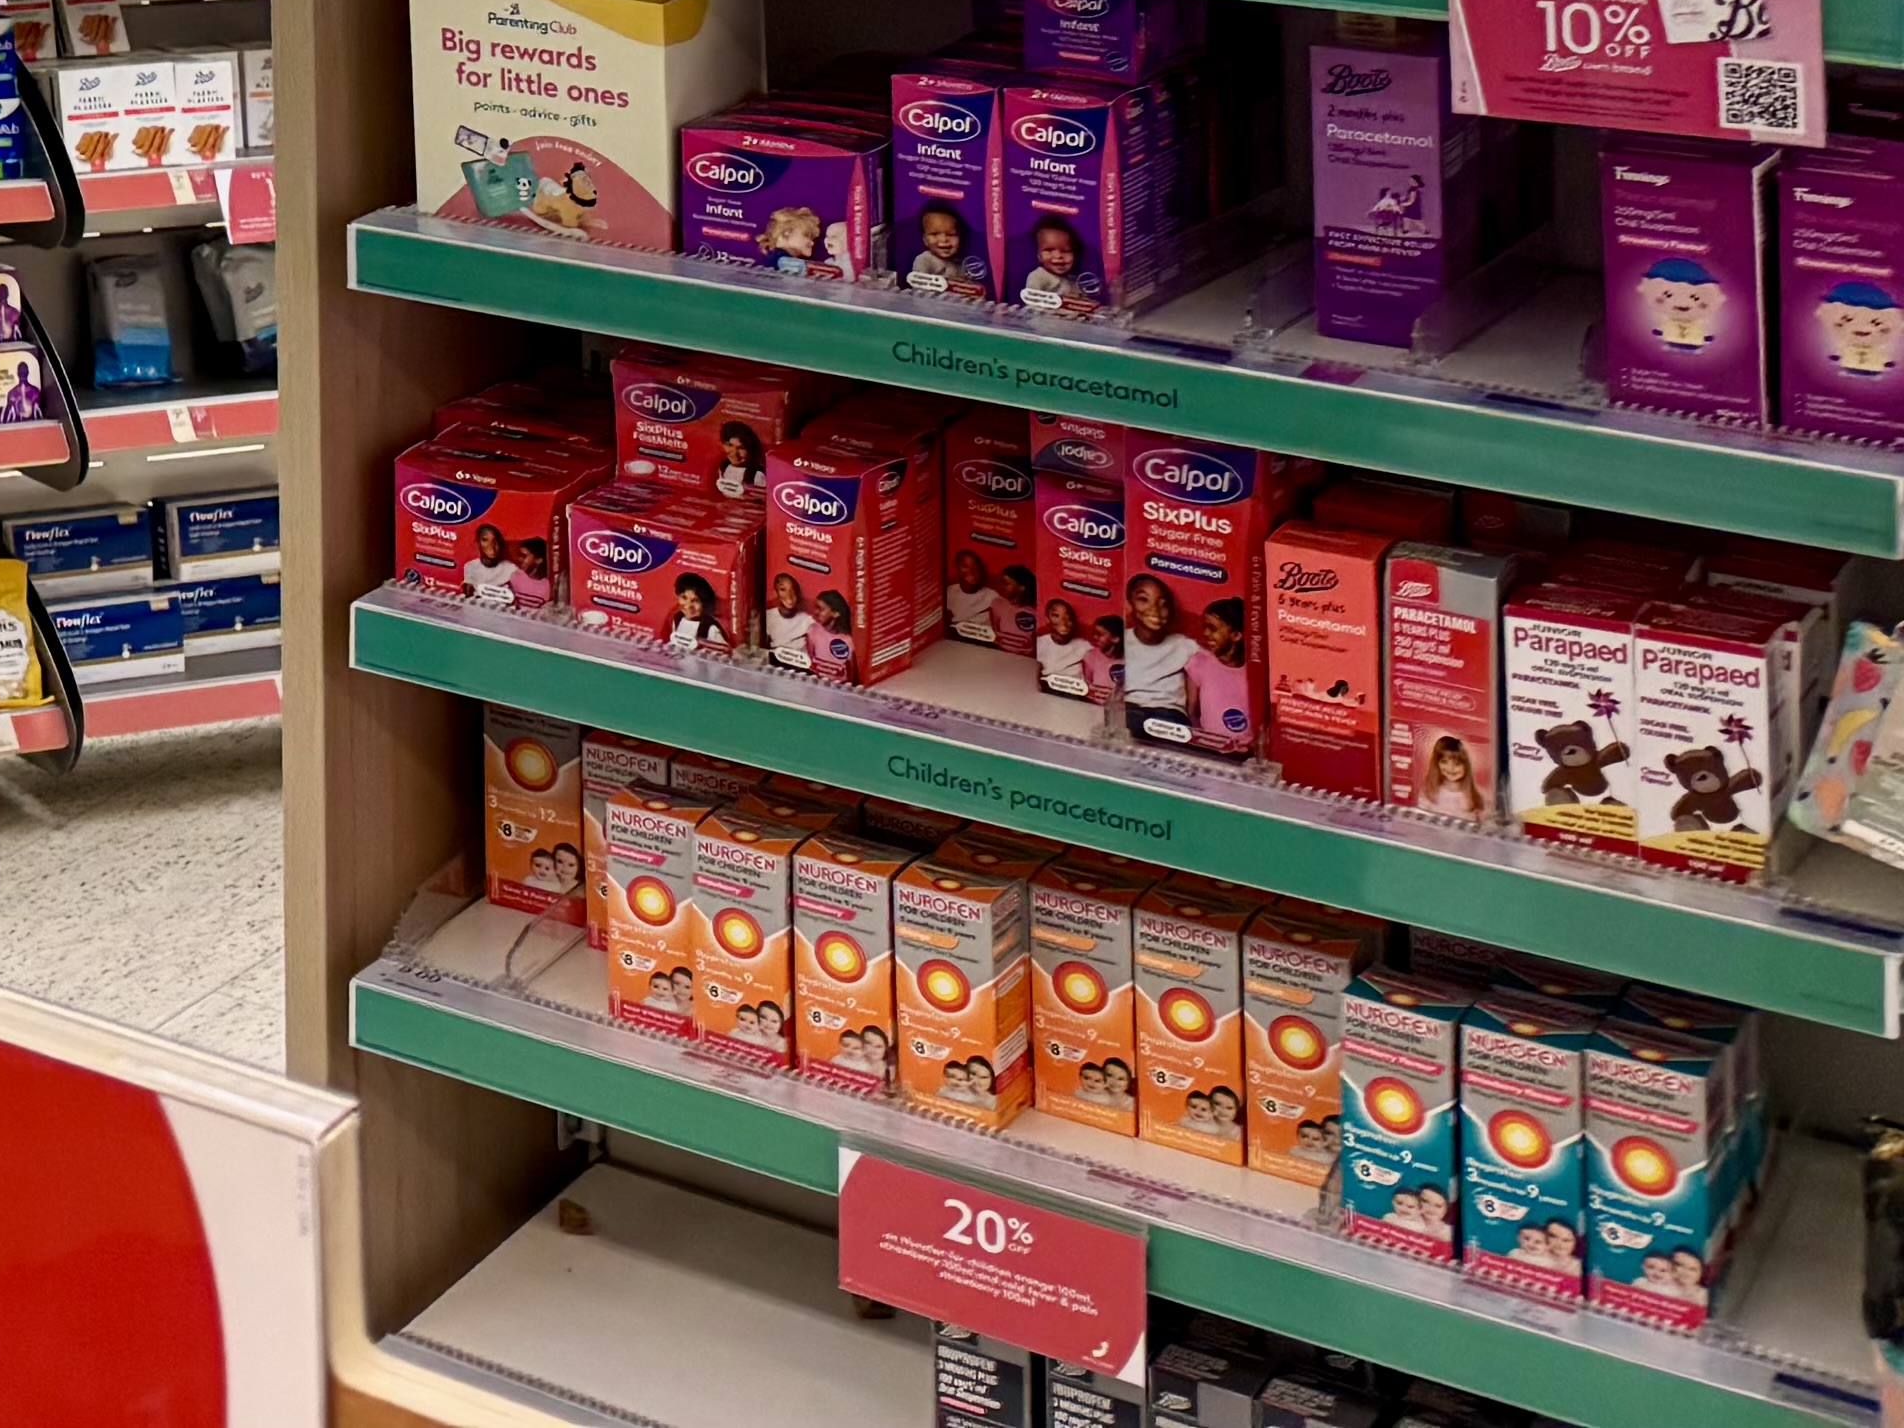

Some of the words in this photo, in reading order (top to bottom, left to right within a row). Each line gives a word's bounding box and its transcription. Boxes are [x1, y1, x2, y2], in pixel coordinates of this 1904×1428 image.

[1536, 2, 1650, 54] 10%
[441, 28, 481, 61] Big
[491, 38, 597, 71] rewards
[1605, 44, 1651, 58] OFF
[456, 63, 492, 90] for
[500, 68, 558, 98] little
[567, 85, 629, 108] ones
[1322, 65, 1392, 96] Boots
[474, 101, 510, 117] points
[521, 105, 560, 123] advice
[570, 113, 597, 127] gifts
[1326, 124, 1433, 148] Paracetamol
[917, 144, 961, 160] Infant
[893, 341, 1008, 380] Children's
[1016, 365, 1178, 409] paracetamol
[1144, 457, 1232, 492] Calpol
[406, 490, 464, 515] Calpol
[1143, 501, 1232, 534] SixPlus
[786, 523, 832, 543] SixPlus
[1147, 538, 1226, 563] Suspension
[1150, 557, 1223, 579] Paracetamol
[1274, 561, 1339, 593] Boots
[1279, 609, 1366, 635] Paracetamol
[1394, 606, 1476, 633] PARACETAMOL
[1514, 627, 1627, 664] Parapaed
[888, 755, 1002, 801] Children's
[1010, 787, 1172, 841] paracetamol
[611, 810, 687, 837] NUROFEN
[798, 862, 878, 893] NUROFEN
[899, 904, 916, 916] FOR
[919, 909, 965, 927] CHILDREN
[1346, 1002, 1440, 1036] NUROFEN
[943, 1199, 1033, 1254] 20%
[1008, 1243, 1031, 1254] OFF
